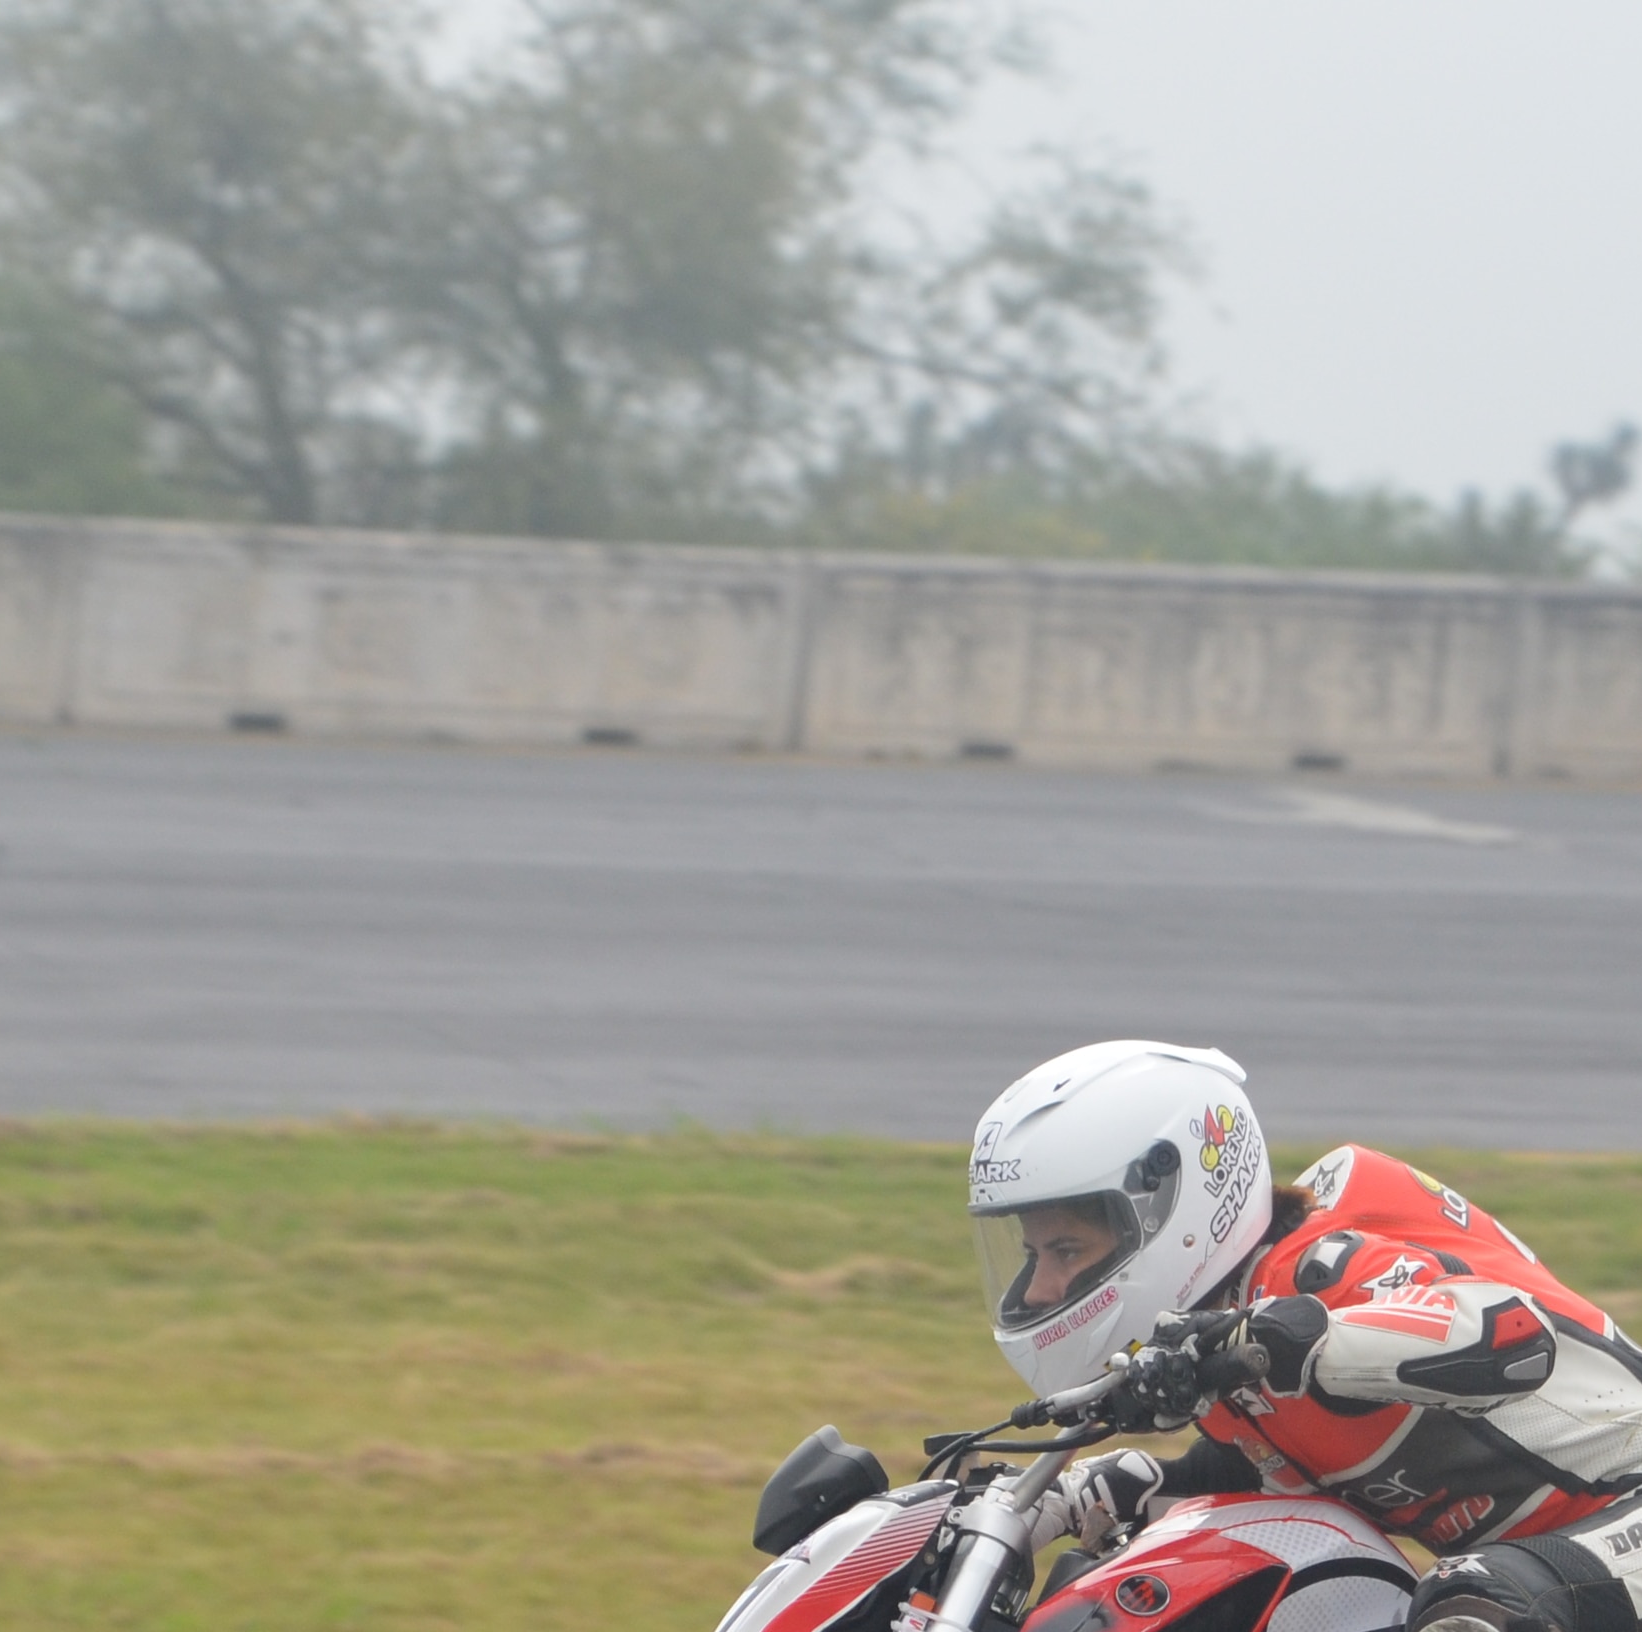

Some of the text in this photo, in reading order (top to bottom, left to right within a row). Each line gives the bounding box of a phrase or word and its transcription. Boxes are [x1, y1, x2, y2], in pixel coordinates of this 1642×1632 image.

[1204, 1106, 1247, 1198] LORENZO
[1210, 1117, 1262, 1243] SHARK
[1032, 1286, 1118, 1350] NURIA LLABRES
